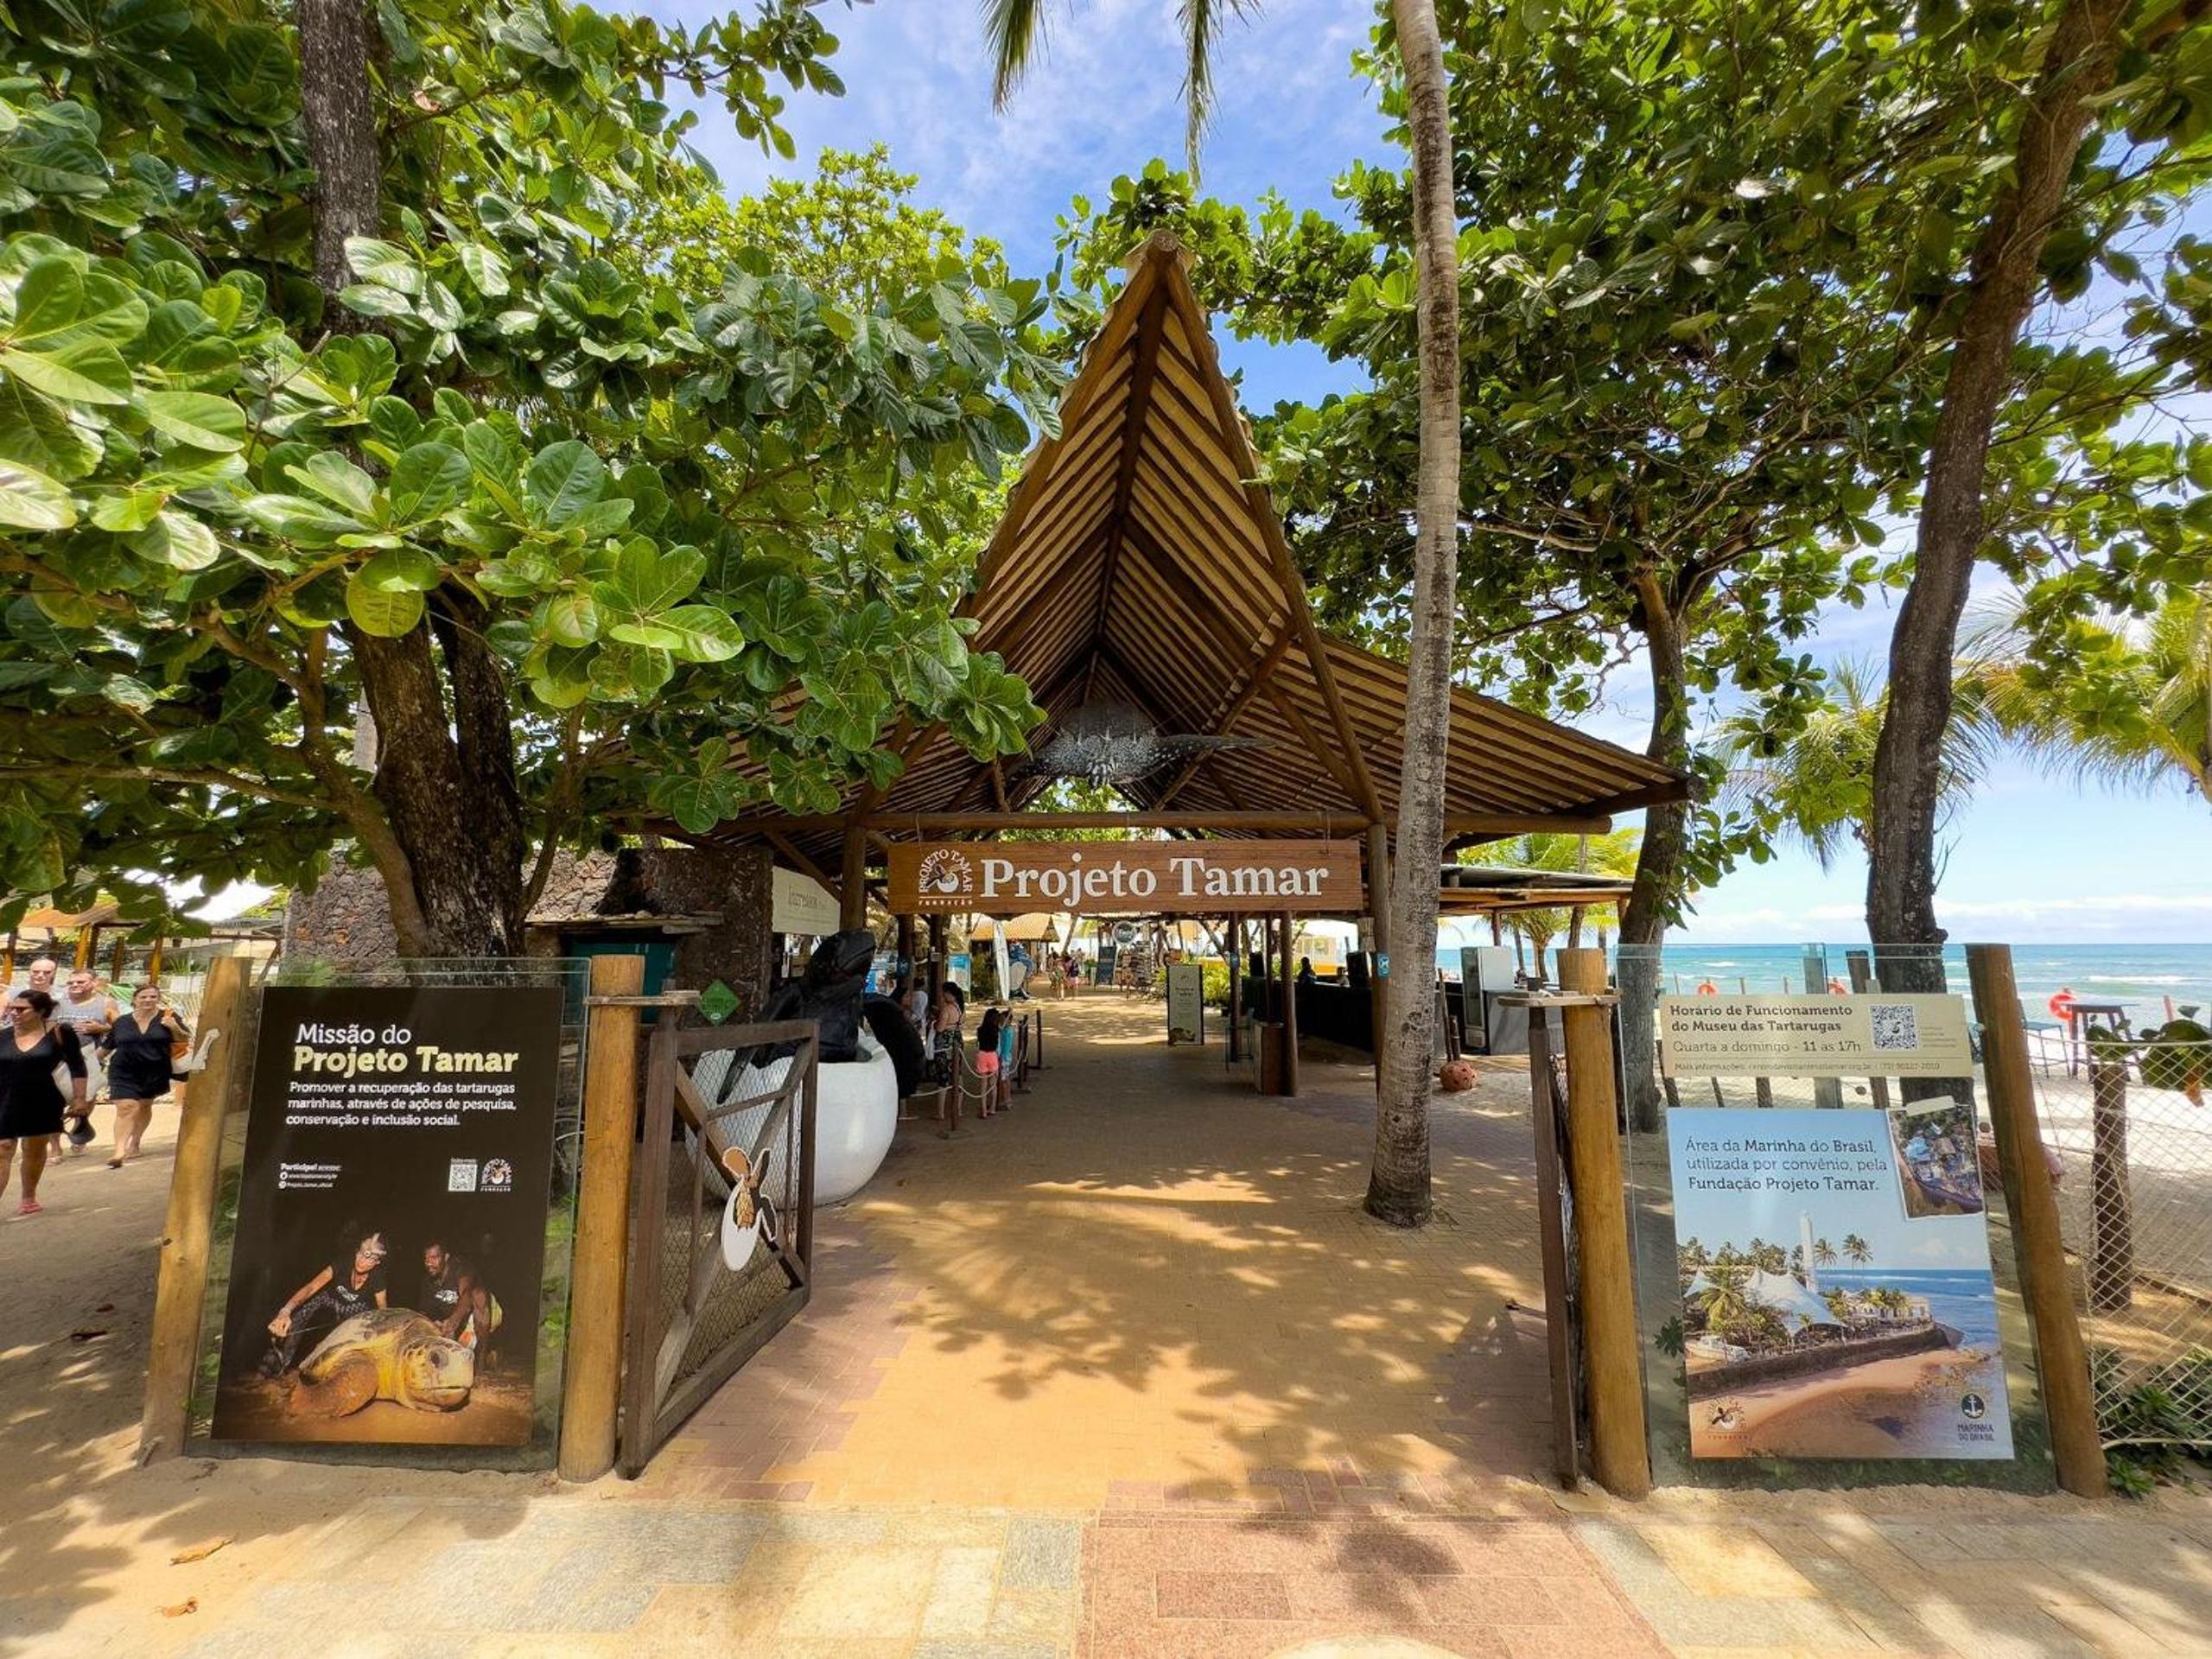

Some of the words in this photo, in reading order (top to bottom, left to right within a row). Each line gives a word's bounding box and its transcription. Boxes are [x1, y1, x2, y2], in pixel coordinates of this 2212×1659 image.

[918, 849, 950, 893] PROJETO
[950, 849, 973, 893] TAMAR
[980, 852, 1157, 907] Projeto
[1170, 857, 1330, 896] Tamar
[1670, 1005, 1722, 1015] Horário
[1726, 1005, 1742, 1015] de
[1745, 1005, 1853, 1015] Funcionamento
[296, 1024, 375, 1044] Missão
[382, 1025, 411, 1044] do
[1672, 1020, 1689, 1032] do
[1693, 1020, 1737, 1032] Museu
[1741, 1020, 1764, 1032] das
[1767, 1020, 1841, 1033] Tartarugas
[1673, 1040, 1717, 1052] Quarta
[1732, 1040, 1789, 1052] domingo
[1803, 1040, 1816, 1052] 11
[294, 1046, 408, 1078] Projeto
[416, 1046, 518, 1072] Tamar
[289, 1082, 346, 1093] Promover
[347, 1084, 356, 1093] a
[358, 1082, 430, 1096] recuperação
[433, 1082, 454, 1093] das
[456, 1083, 516, 1096] tartarugas
[288, 1097, 345, 1109] marinhas,
[346, 1098, 389, 1109] através
[391, 1098, 406, 1109] de
[408, 1098, 443, 1112] ações
[445, 1098, 461, 1109] de
[462, 1098, 517, 1112] pesquisa,
[286, 1114, 359, 1127] conservação
[361, 1116, 370, 1125] e
[372, 1114, 422, 1125] inclusão
[423, 1114, 461, 1125] social.
[1686, 1135, 1719, 1151] Área
[1722, 1140, 1740, 1151] da
[1745, 1140, 1806, 1152] Marinha
[1810, 1140, 1829, 1152] do
[1833, 1140, 1878, 1154] Brasil,
[1687, 1157, 1749, 1170] utilizada
[1753, 1160, 1777, 1172] por
[1782, 1157, 1853, 1171] convênio,
[1857, 1158, 1887, 1172] pela
[1688, 1176, 1762, 1192] Fundação
[1766, 1177, 1819, 1192] Projeto
[1823, 1176, 1879, 1191] Tamar.
